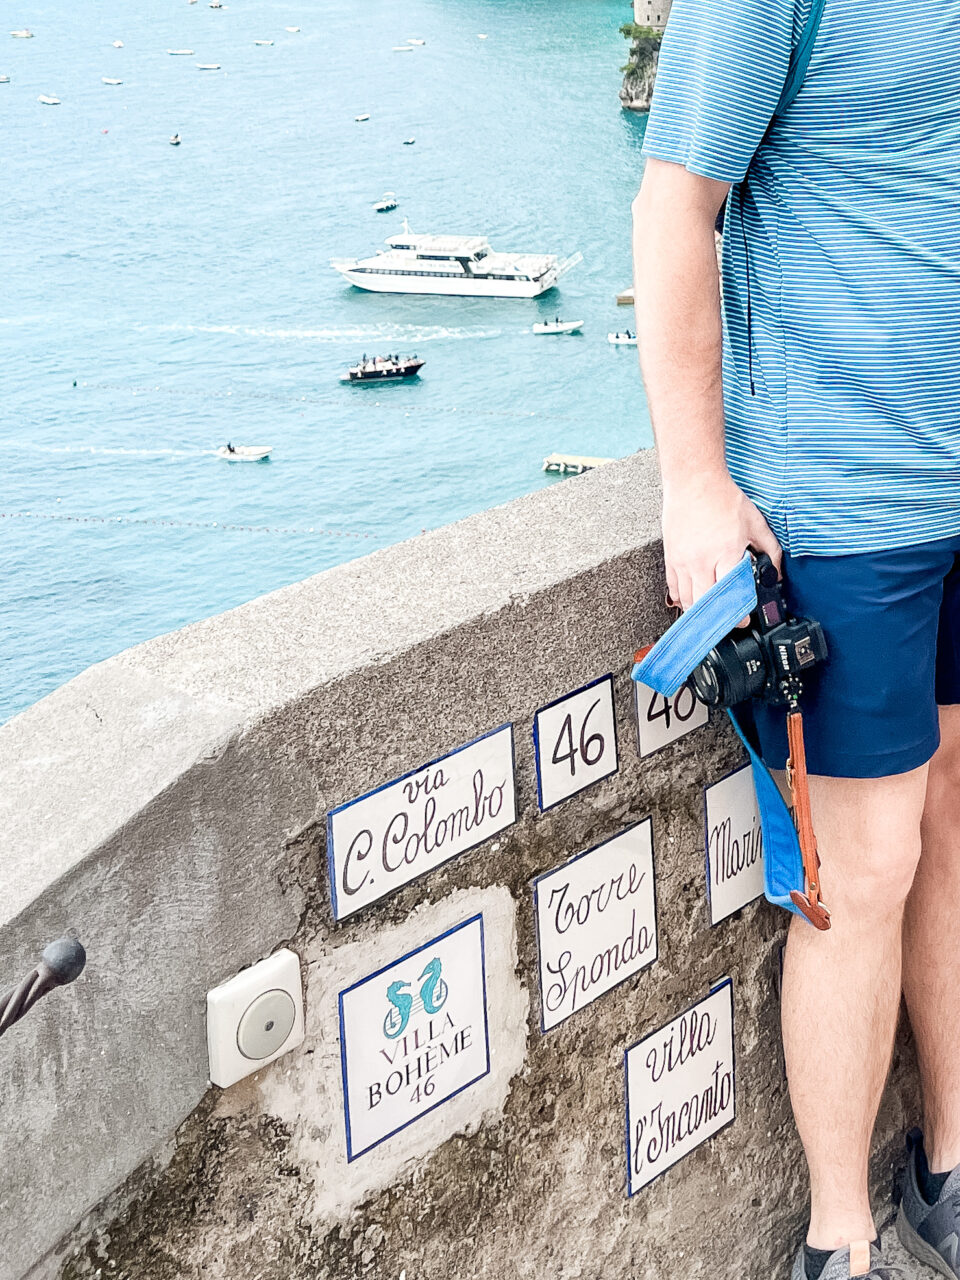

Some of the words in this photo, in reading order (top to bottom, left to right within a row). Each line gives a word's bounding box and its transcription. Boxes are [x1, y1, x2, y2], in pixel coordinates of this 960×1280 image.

[552, 698, 605, 776] 46
[402, 769, 450, 804] via
[342, 829, 375, 896] C.
[382, 769, 507, 872] Colombo
[548, 863, 646, 934] Torre
[545, 908, 654, 1012] Sponda
[367, 1025, 473, 1111] BOHÈME
[379, 1012, 456, 1065] VILLA
[409, 1073, 436, 1104] 46
